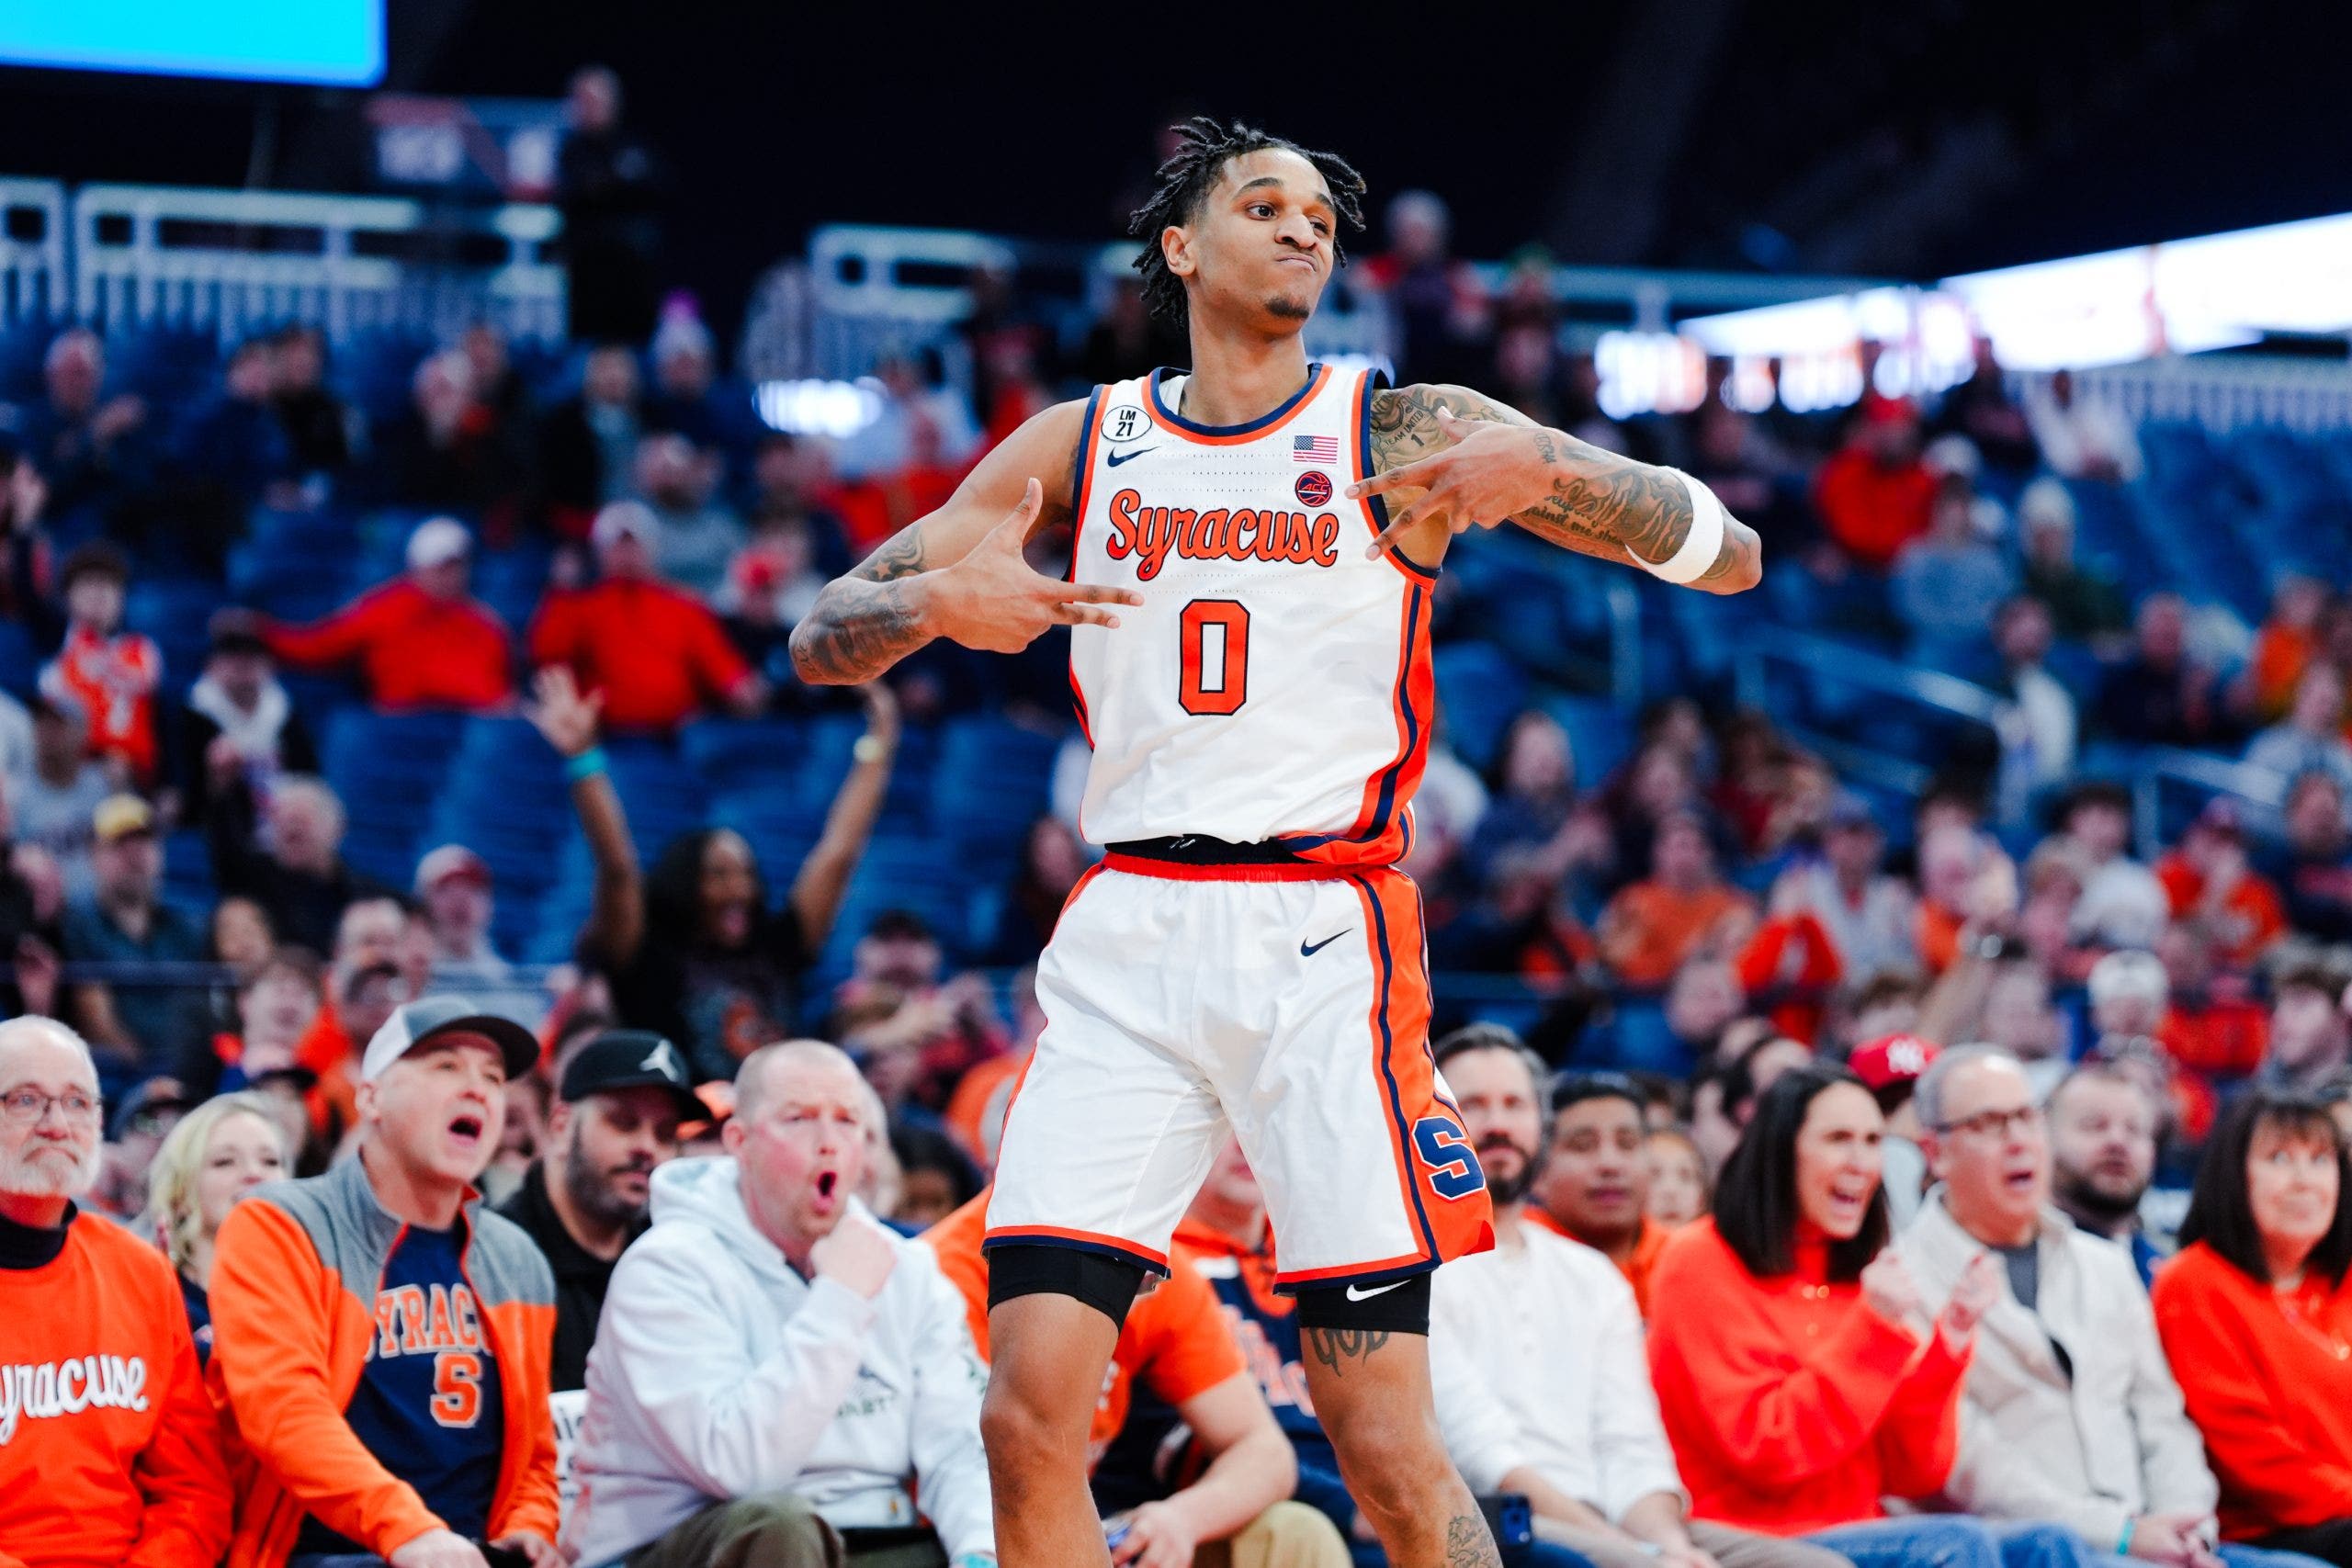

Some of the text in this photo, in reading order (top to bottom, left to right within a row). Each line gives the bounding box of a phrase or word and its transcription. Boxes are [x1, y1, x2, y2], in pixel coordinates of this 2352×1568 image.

[1115, 422, 1134, 436] 21
[1119, 410, 1136, 421] LM
[1385, 431, 1406, 447] TEAM
[1301, 483, 1330, 492] ACC
[1106, 489, 1339, 581] Syracuse
[1179, 599, 1250, 716] 0
[1411, 1115, 1486, 1201] S
[364, 1283, 493, 1362] YRAC
[0, 1354, 150, 1447] yracuse
